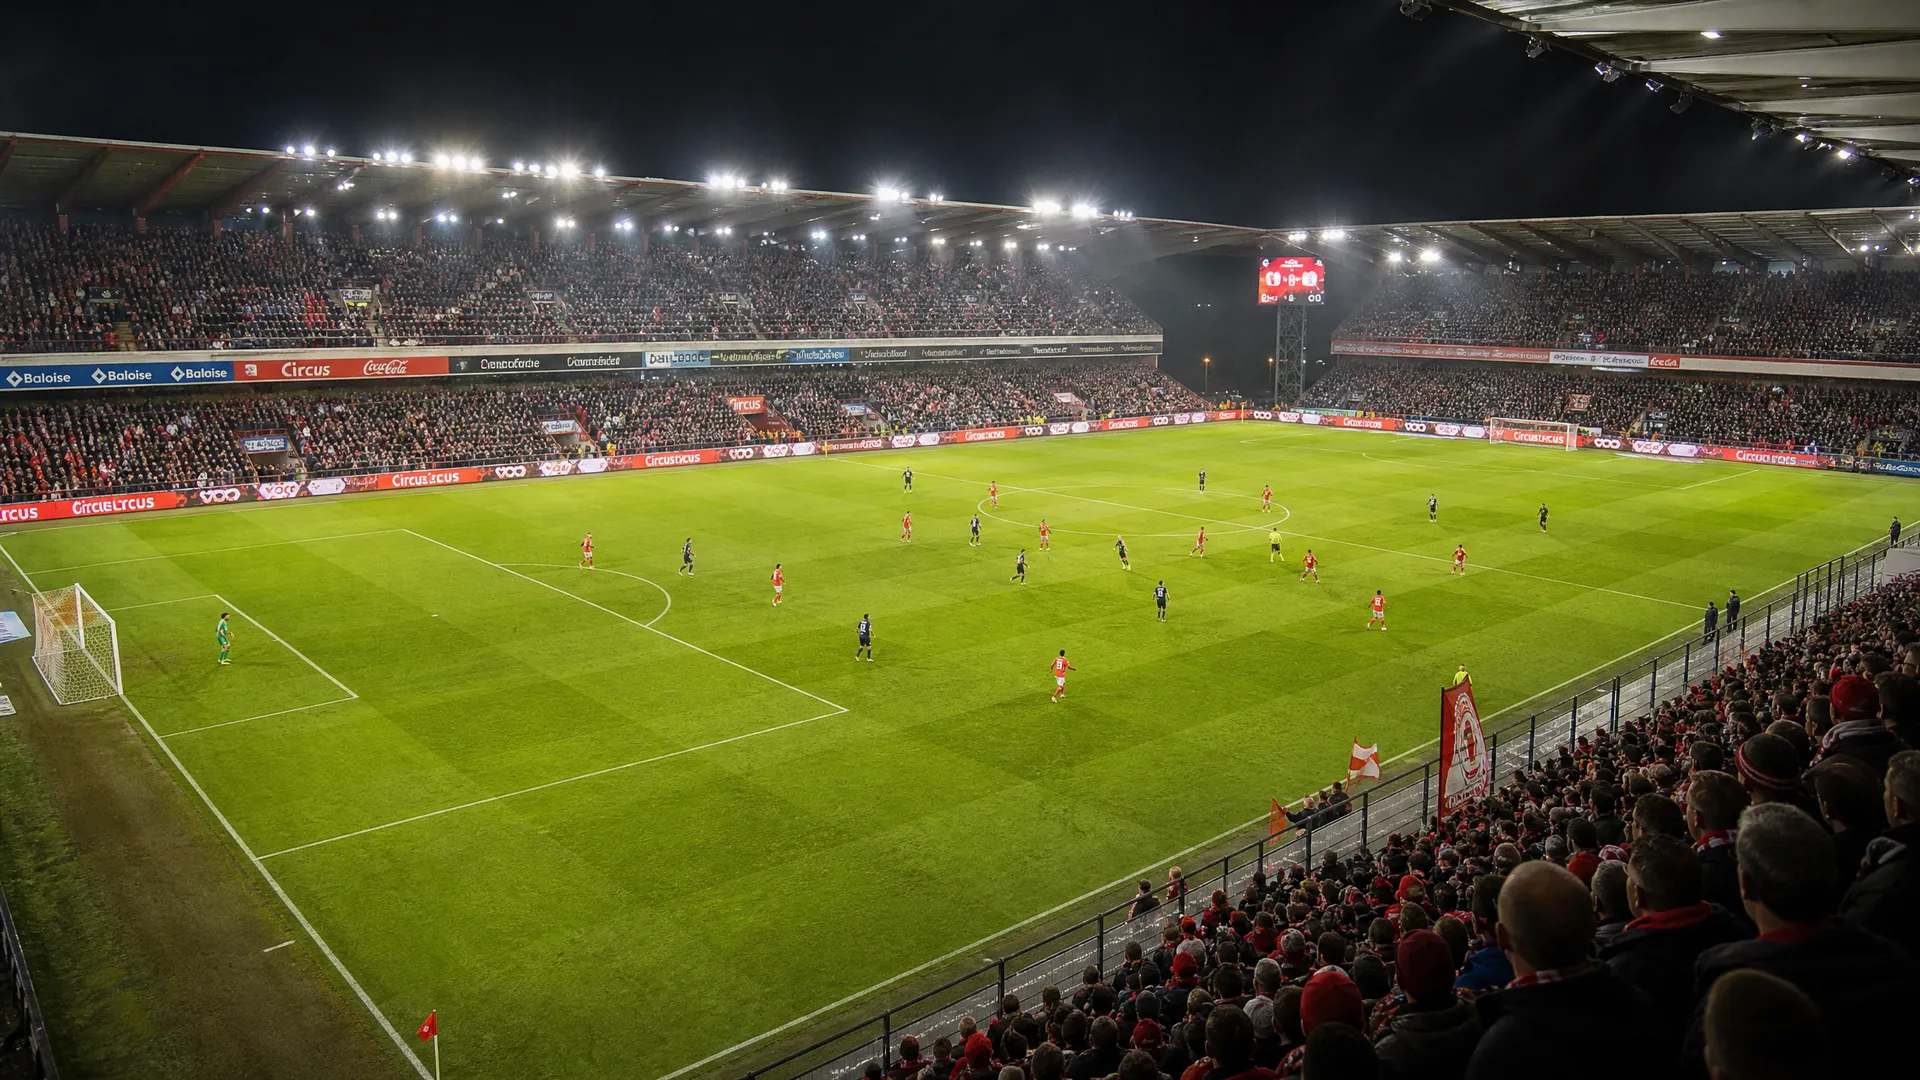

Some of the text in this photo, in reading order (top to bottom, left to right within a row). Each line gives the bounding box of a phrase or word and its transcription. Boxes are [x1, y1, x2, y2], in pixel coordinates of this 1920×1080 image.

[108, 369, 152, 381] Baloise
[186, 367, 228, 379] Baloise
[281, 362, 330, 377] Circus
[24, 372, 71, 384] Baloise
